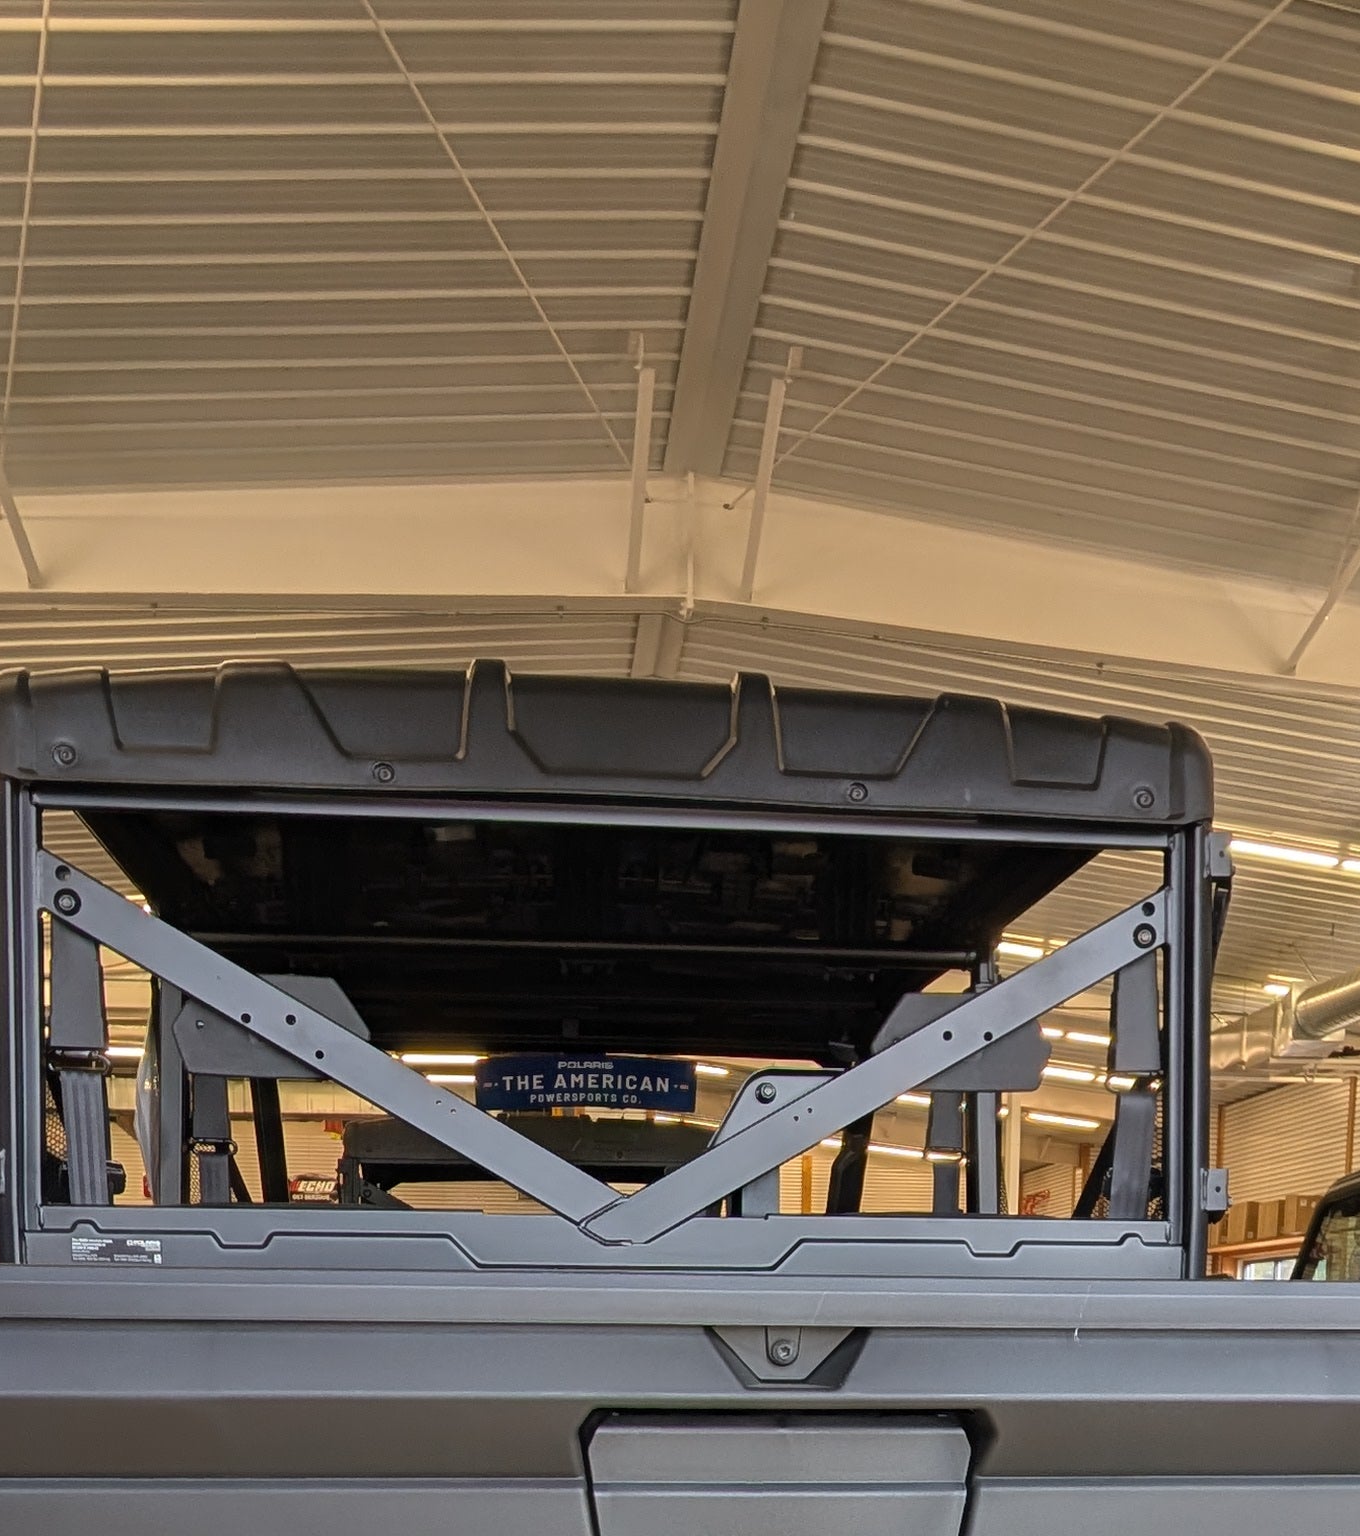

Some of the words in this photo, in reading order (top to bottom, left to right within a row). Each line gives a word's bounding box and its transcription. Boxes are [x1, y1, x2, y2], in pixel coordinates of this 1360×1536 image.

[557, 1060, 615, 1071] POLARIS
[502, 1074, 545, 1092] THE
[553, 1073, 670, 1094] AMERICAN
[529, 1092, 618, 1104] POWERSPORTS
[297, 1180, 337, 1192] ECHO
